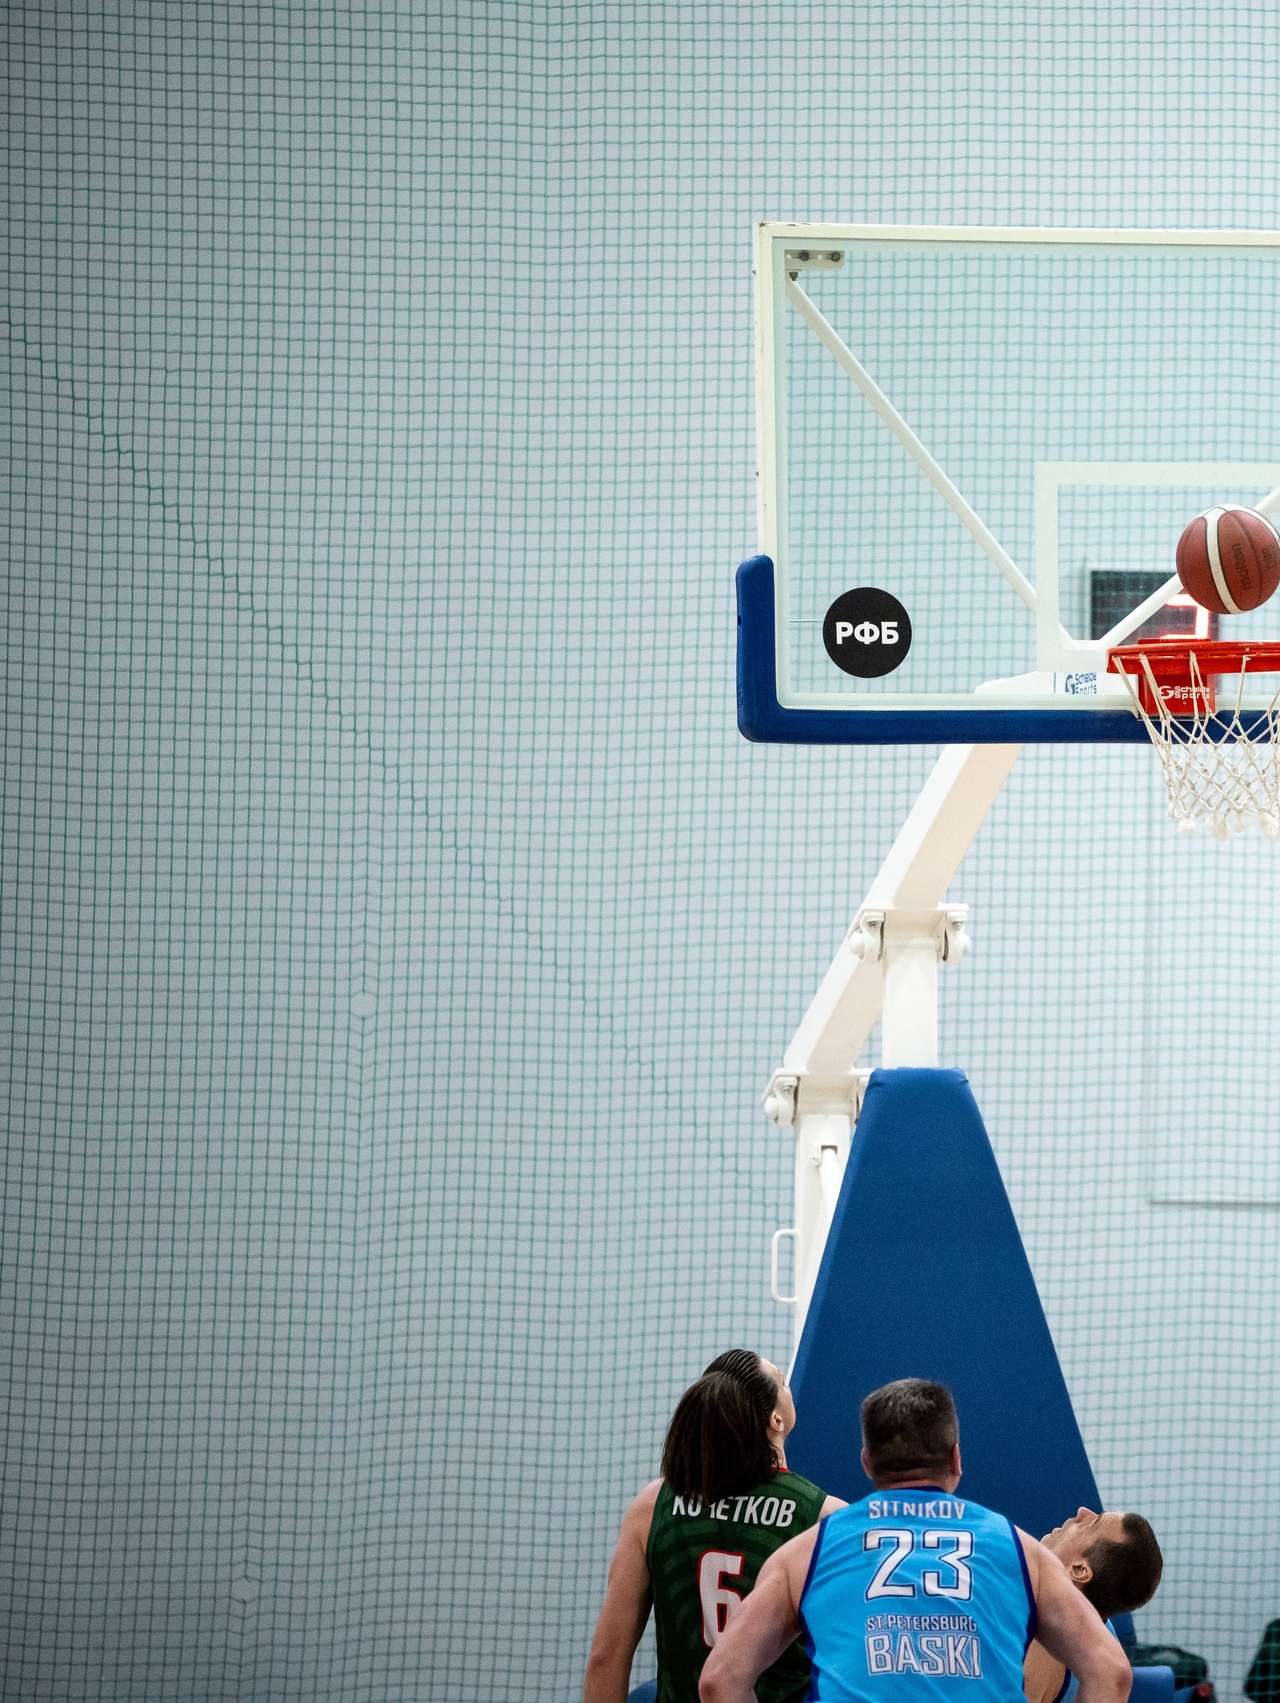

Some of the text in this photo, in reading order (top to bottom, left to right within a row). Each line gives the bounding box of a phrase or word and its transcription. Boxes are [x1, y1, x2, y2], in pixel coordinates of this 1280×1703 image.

[835, 621, 899, 645] РФБ
[868, 1500, 966, 1520] SITNIKOV
[863, 1528, 975, 1602] 23
[698, 1549, 745, 1650] 6
[865, 1633, 983, 1679] BASKI
